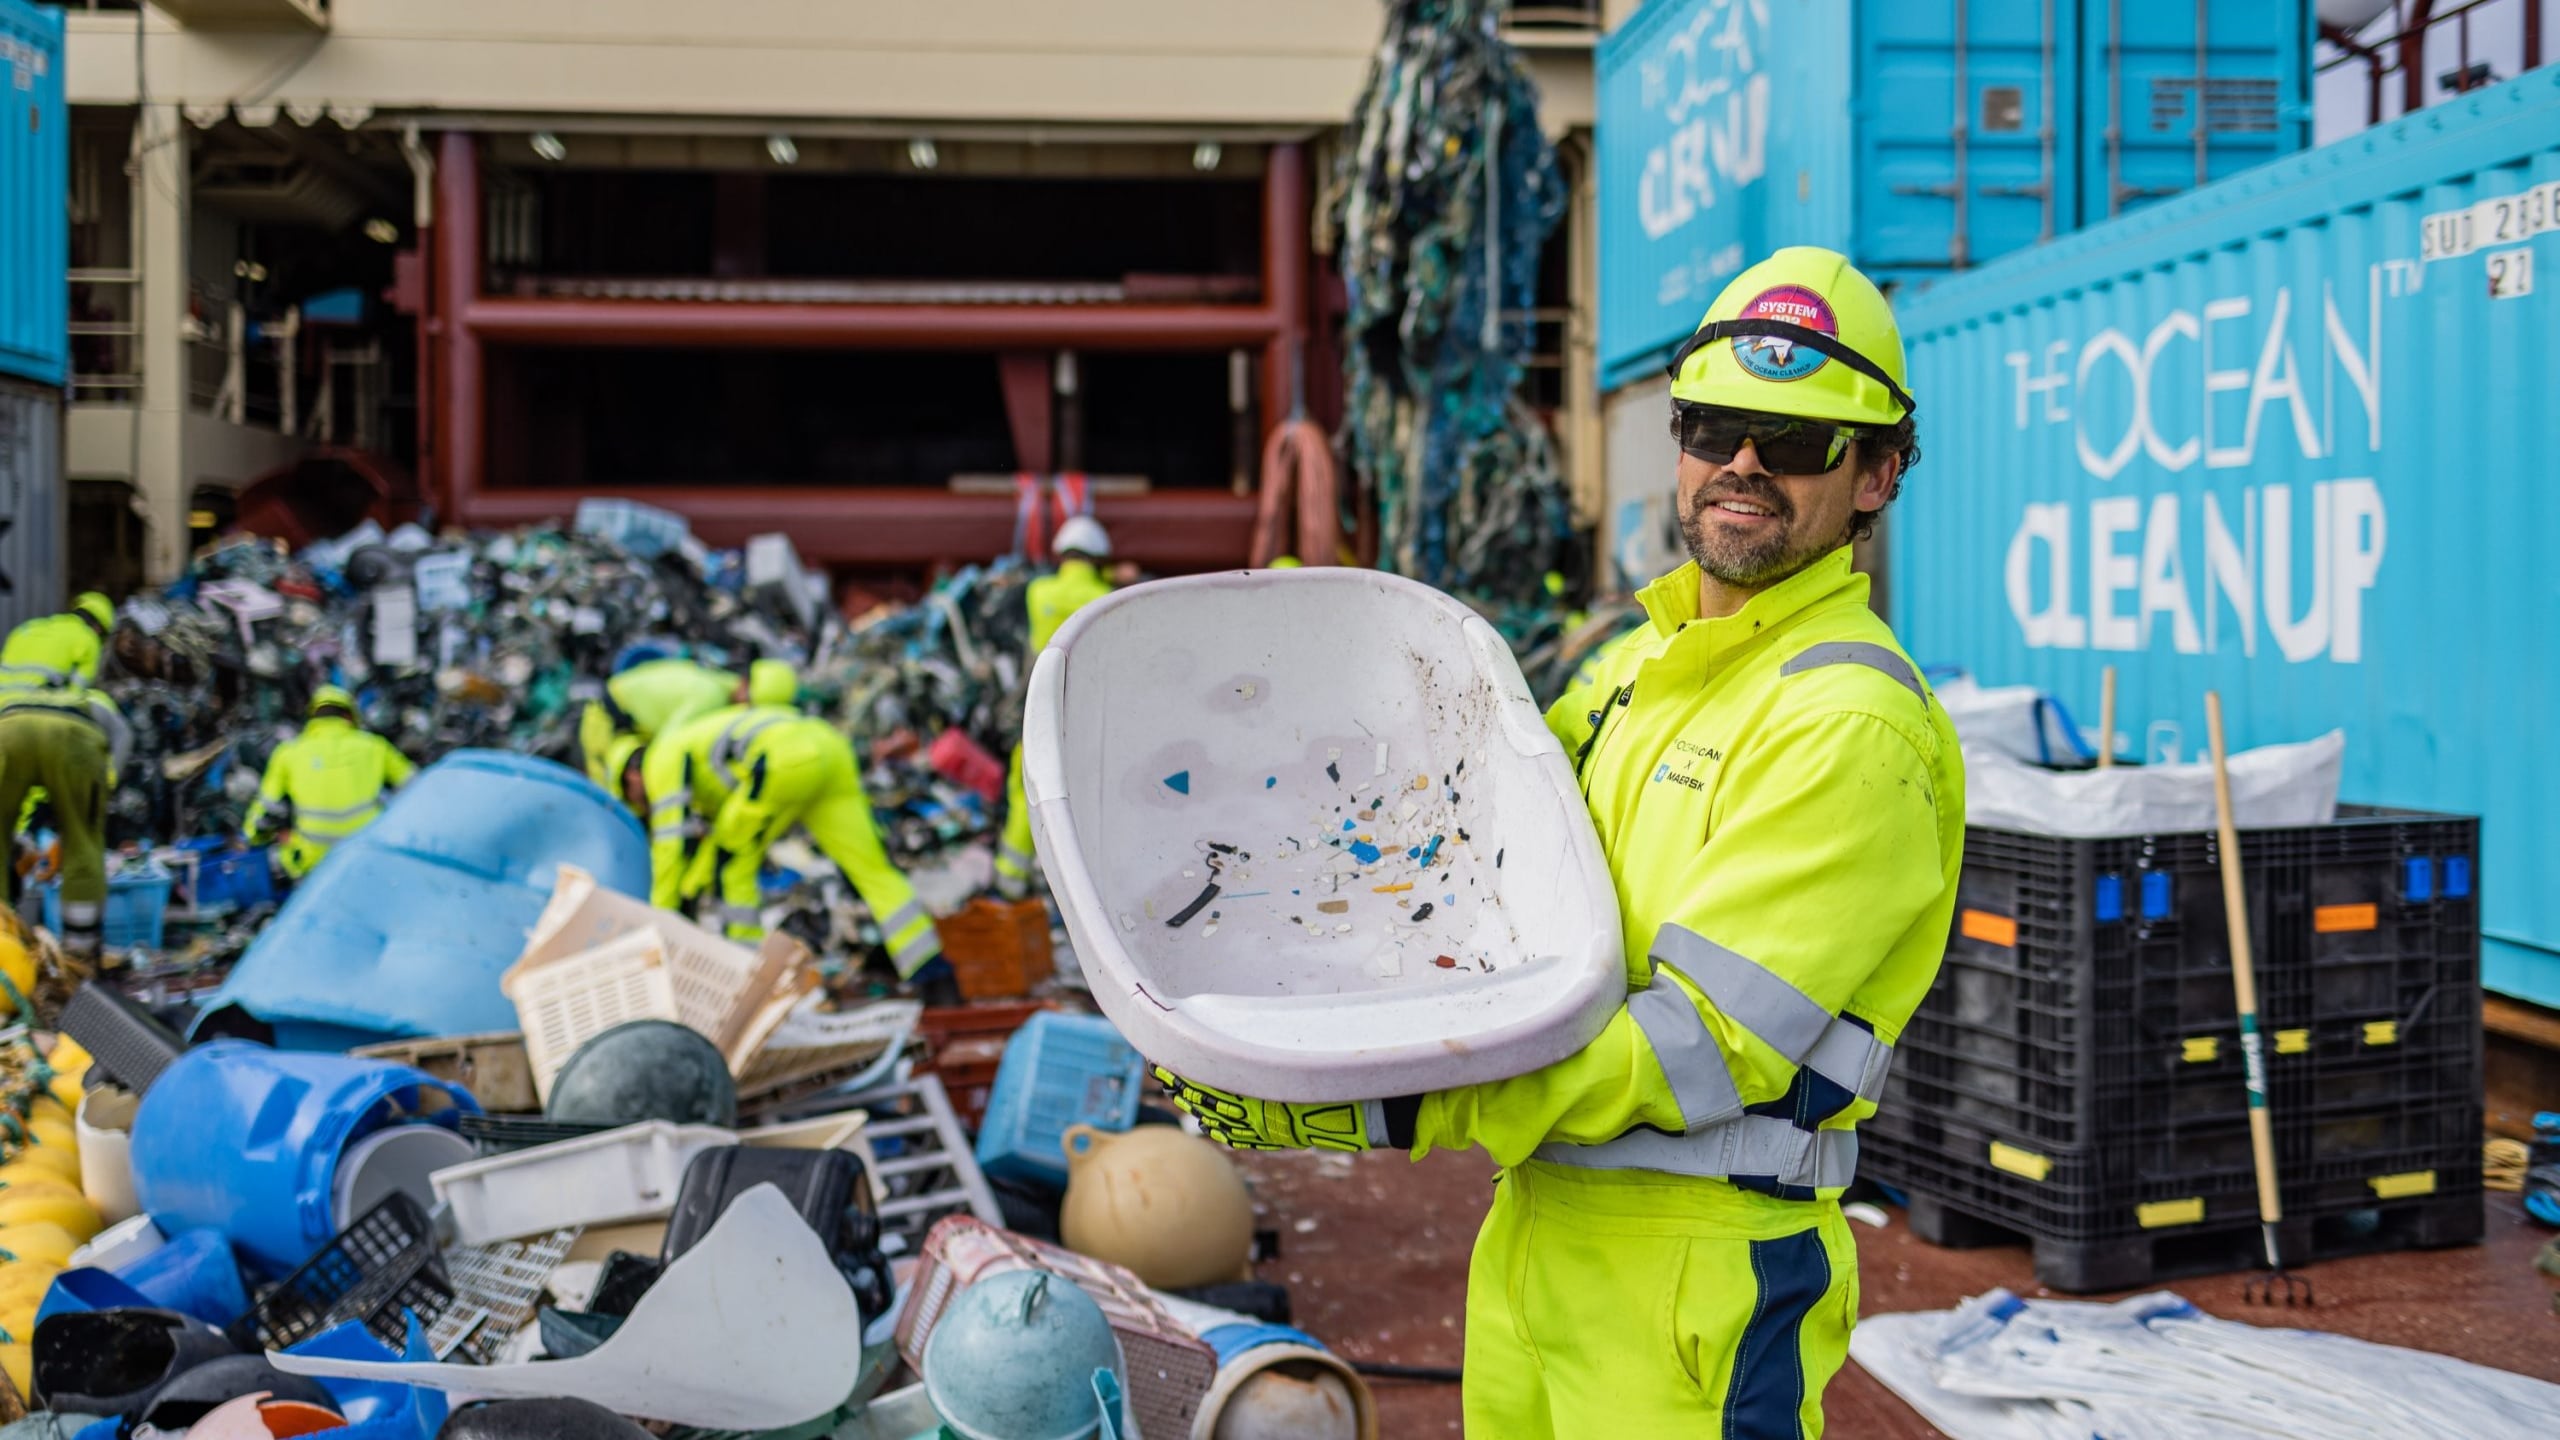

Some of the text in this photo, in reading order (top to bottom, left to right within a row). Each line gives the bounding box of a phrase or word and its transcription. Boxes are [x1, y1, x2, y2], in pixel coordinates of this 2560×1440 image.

[1758, 301, 1818, 319] SYSTEM
[1743, 355, 1811, 377] THE OCEAN CLEANUP
[2005, 341, 2070, 429] THE
[2076, 264, 2381, 479] OCEAN
[2005, 477, 2387, 663] CLEANUP
[1666, 772, 1705, 792] MAERSK
